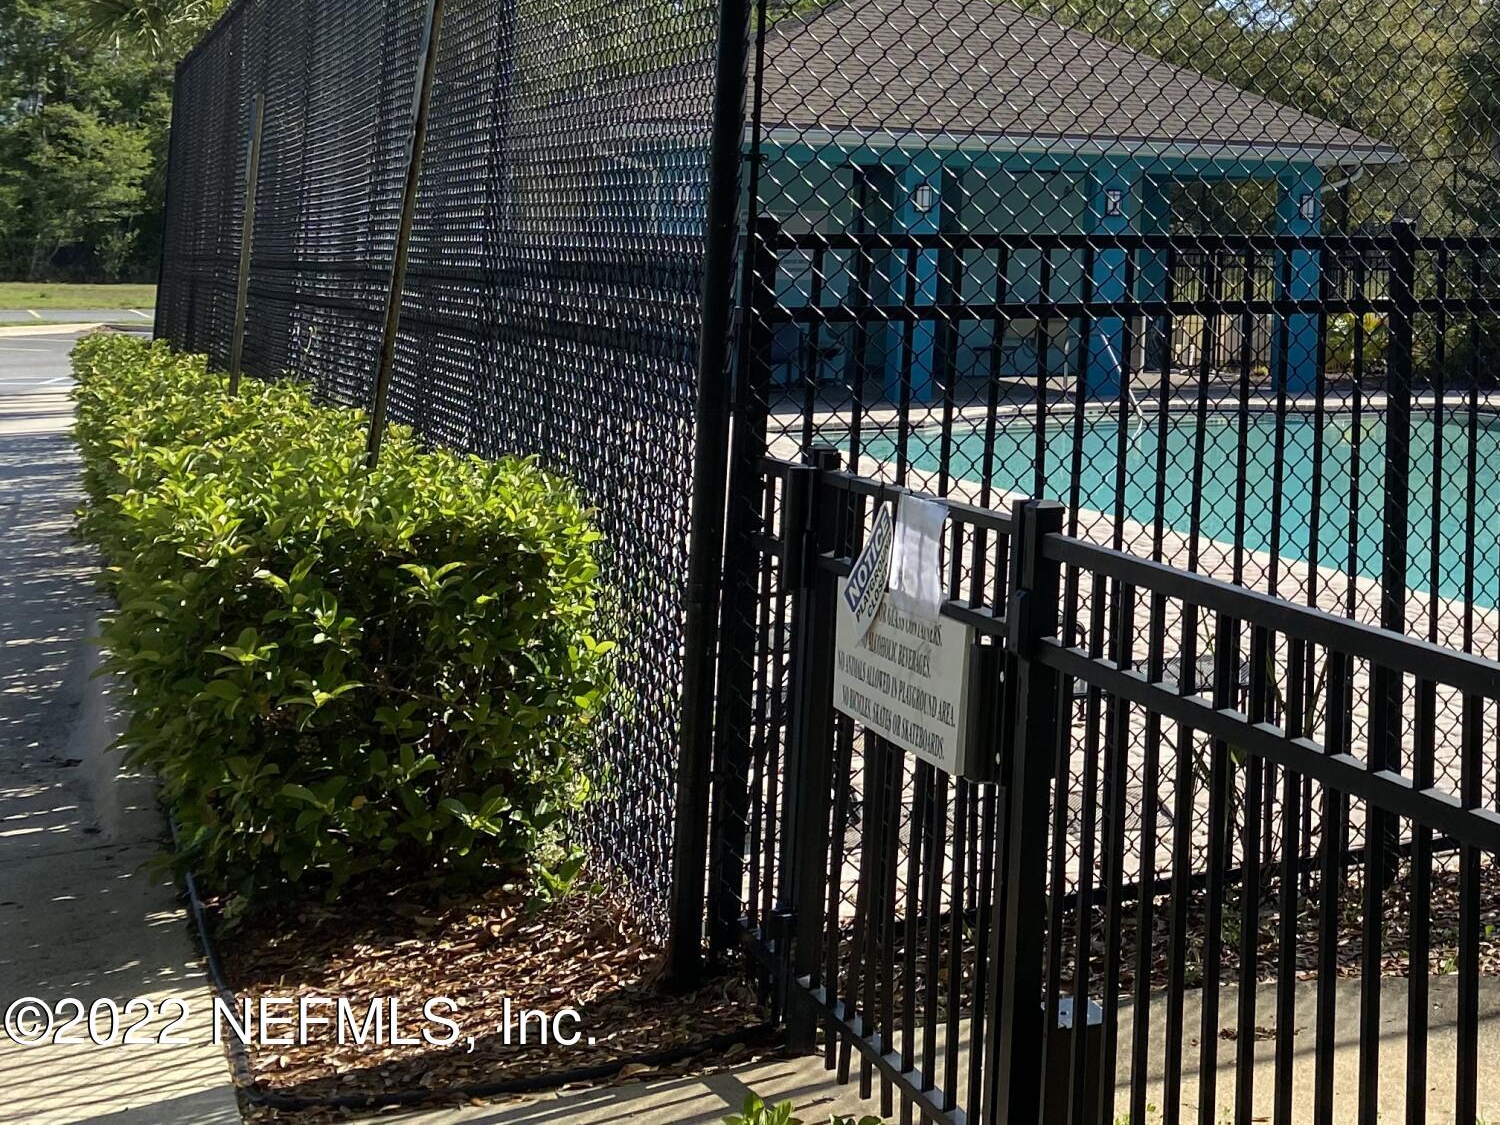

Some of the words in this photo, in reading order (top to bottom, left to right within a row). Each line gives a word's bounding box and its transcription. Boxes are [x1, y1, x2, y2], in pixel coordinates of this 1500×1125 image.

[849, 511, 888, 606] NOTICE
[856, 532, 892, 623] PLAYGROUND
[866, 664, 890, 695] ALLOWED
[890, 676, 898, 698] IN
[898, 679, 937, 719] PLAYGROUND
